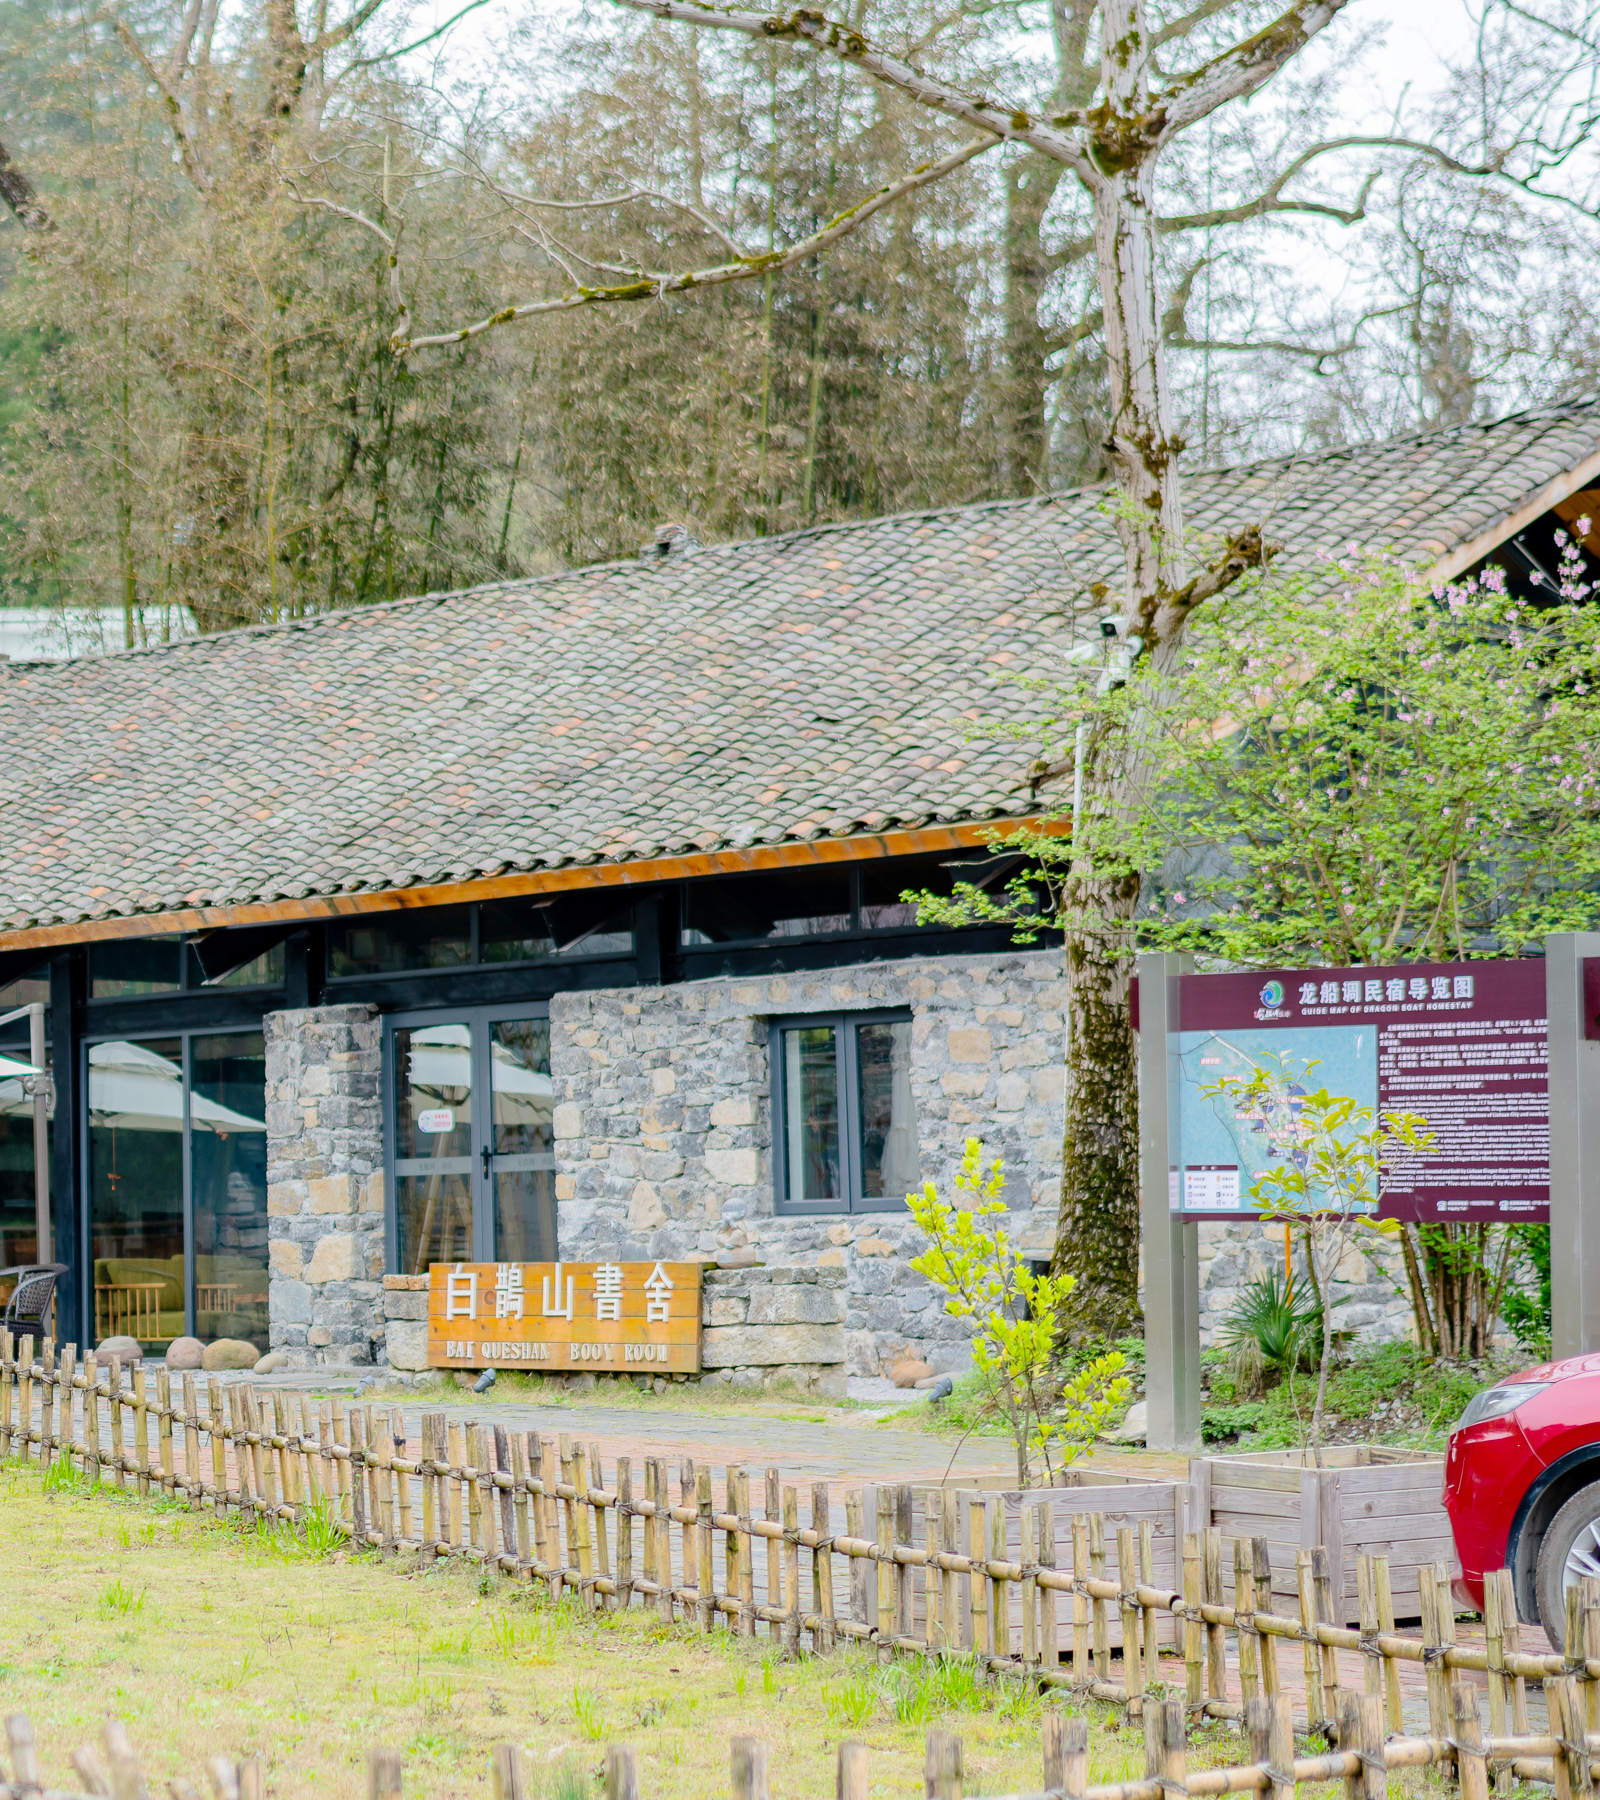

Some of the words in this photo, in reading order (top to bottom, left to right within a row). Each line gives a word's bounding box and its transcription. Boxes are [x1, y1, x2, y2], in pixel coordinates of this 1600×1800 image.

[1299, 976, 1474, 1004] 龙船调民宿导览图
[1301, 1006, 1328, 1015] GUIDE
[1329, 1005, 1347, 1014] MAP
[1350, 1005, 1362, 1013] OF
[1363, 1004, 1399, 1013] DRAGON
[1401, 1003, 1424, 1011] BOAT
[1426, 1001, 1473, 1010] HOMESTAY
[446, 1341, 475, 1358] BAI
[481, 1342, 550, 1360] QUESHAN
[624, 1344, 668, 1362] ROOM
